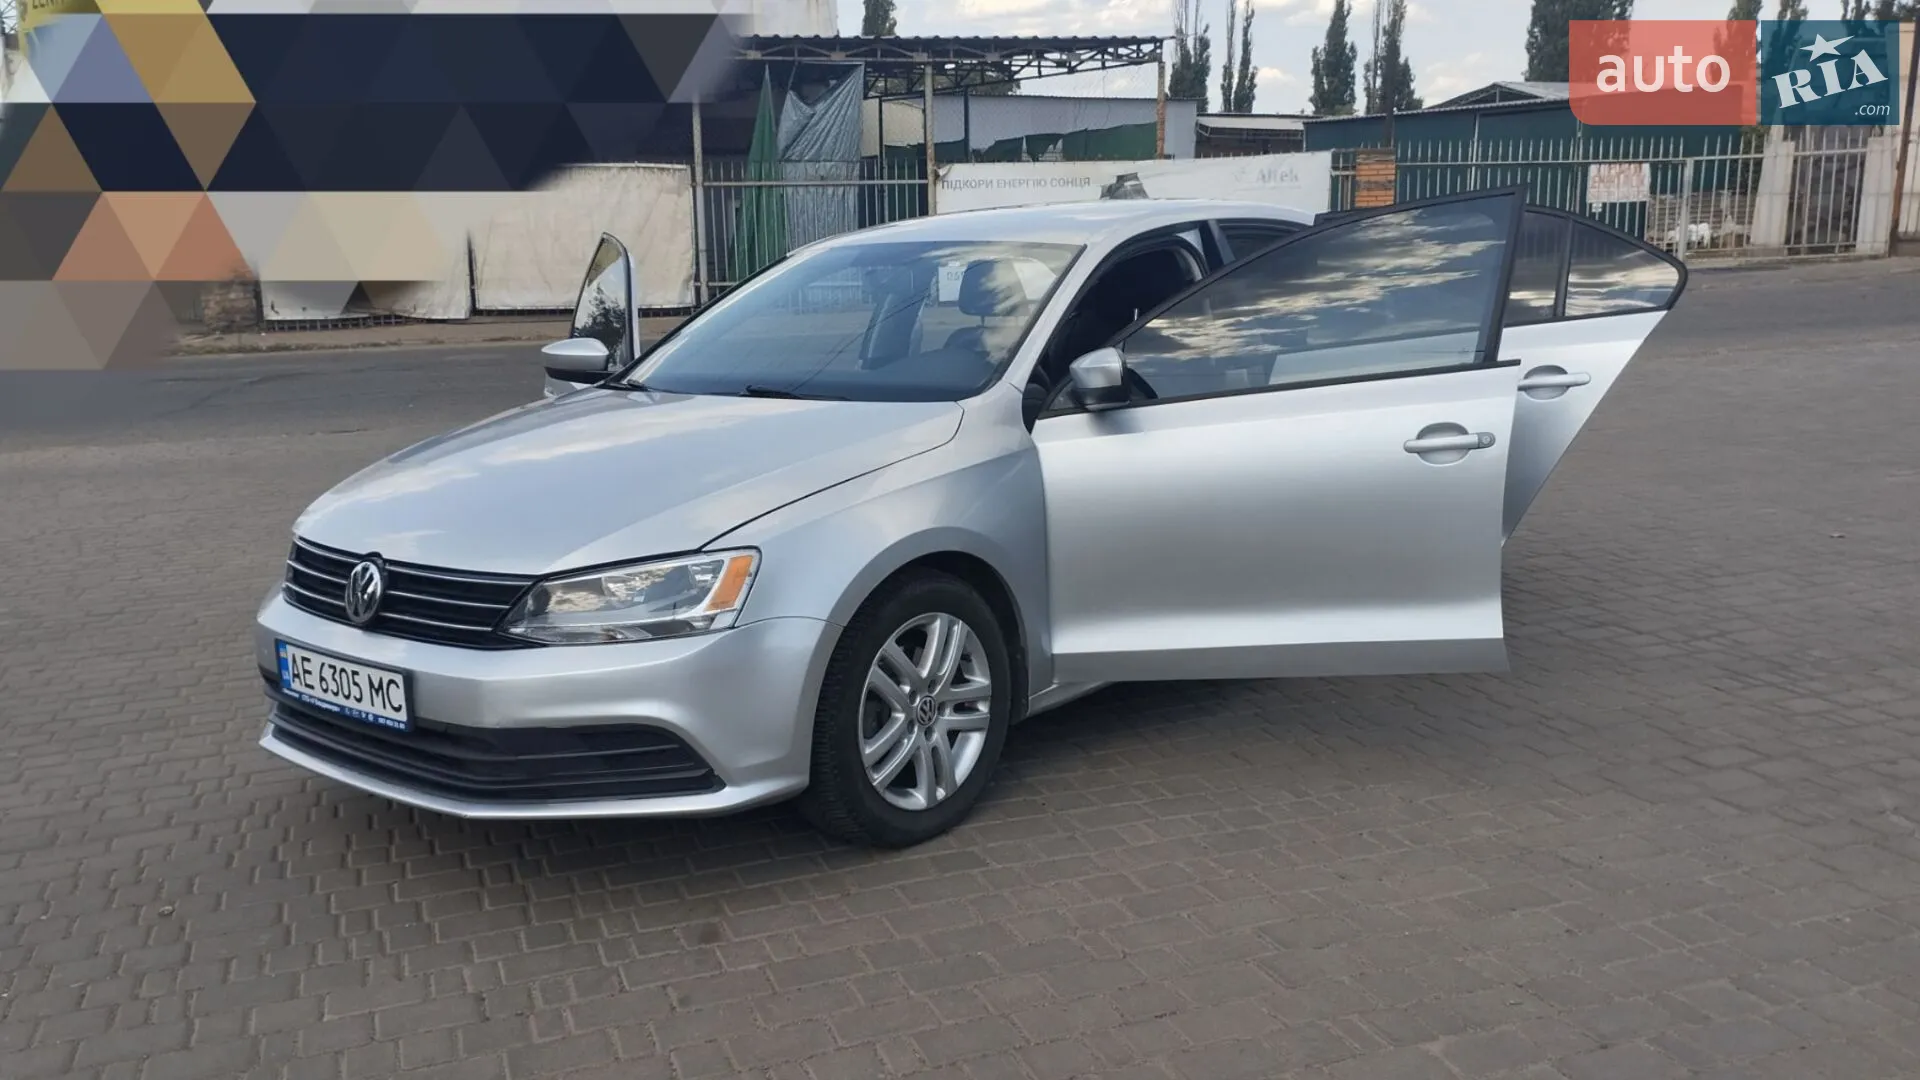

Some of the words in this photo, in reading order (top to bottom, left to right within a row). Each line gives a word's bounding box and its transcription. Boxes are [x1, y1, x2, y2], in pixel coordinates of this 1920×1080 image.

[941, 178, 994, 191] ПІДКОРИ
[1049, 177, 1091, 189] СОНЦЯ
[292, 653, 315, 690] AE
[318, 662, 363, 703] 6305
[368, 674, 403, 713] MC
